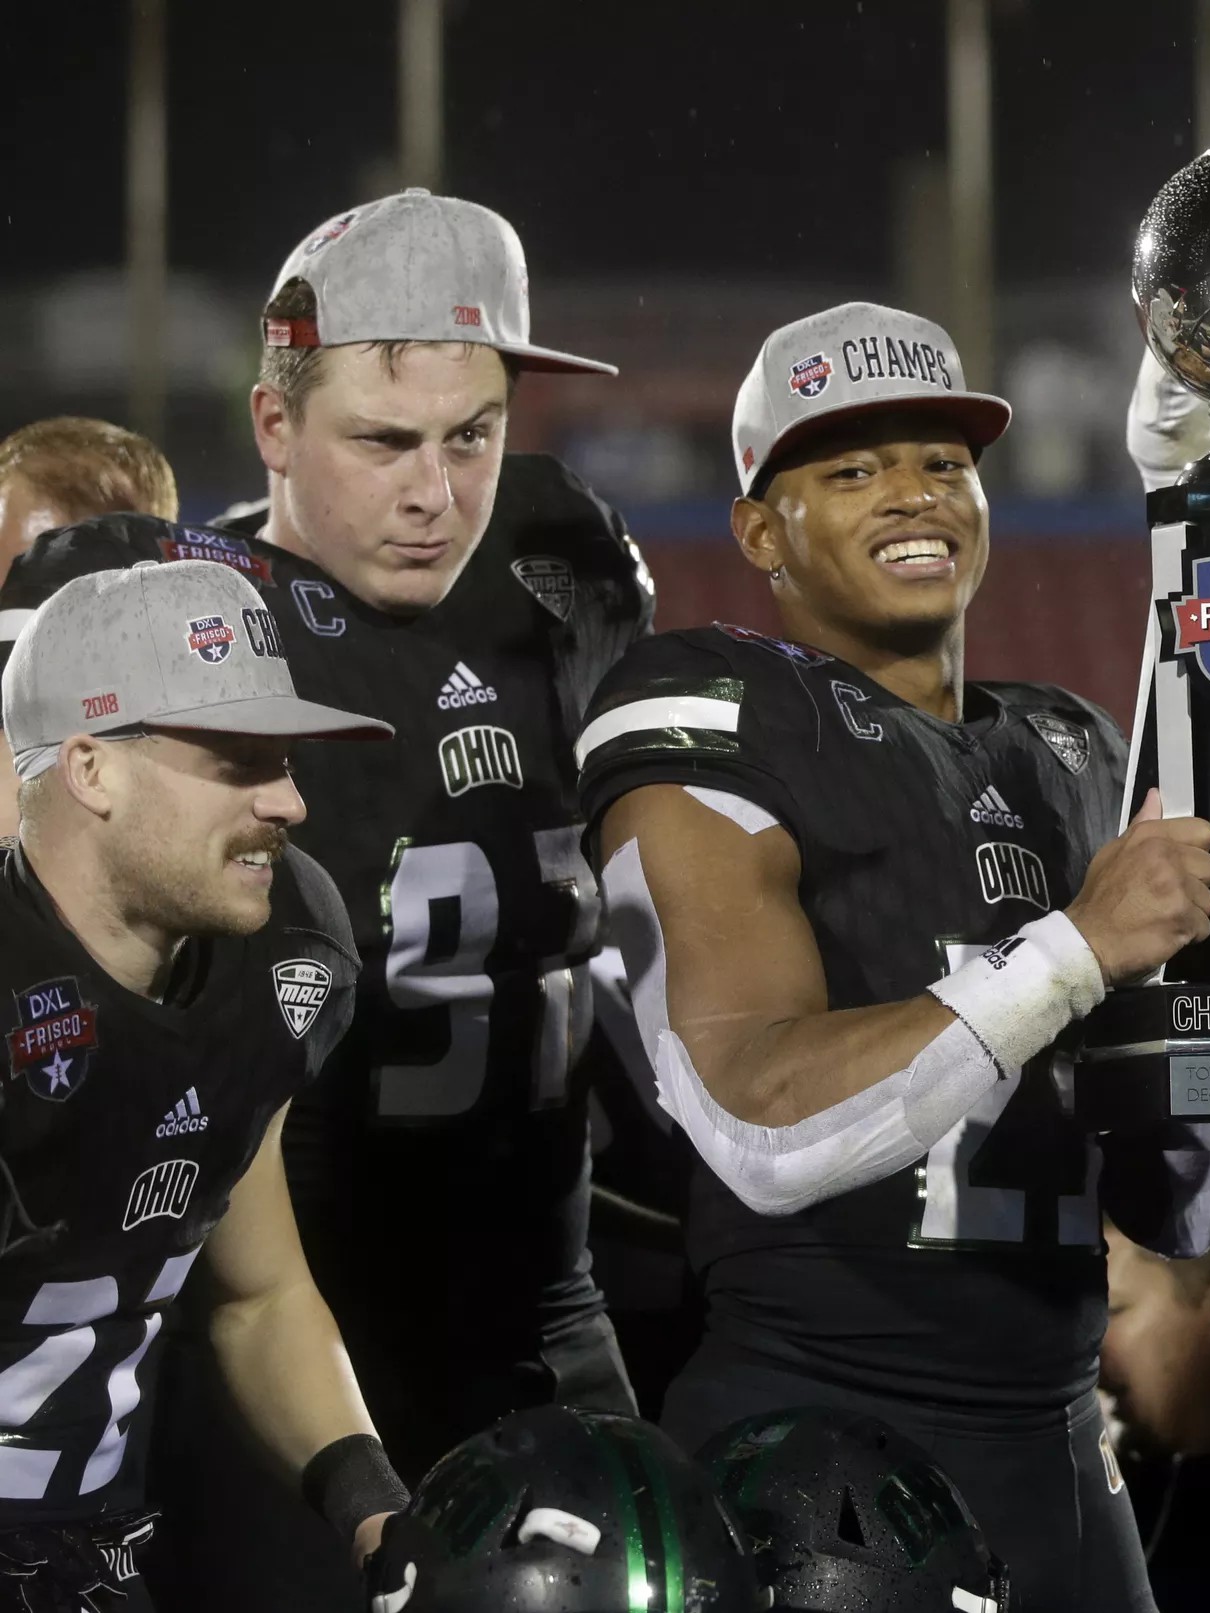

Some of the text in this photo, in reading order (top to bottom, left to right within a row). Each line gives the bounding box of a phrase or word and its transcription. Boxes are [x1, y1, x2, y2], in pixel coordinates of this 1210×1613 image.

[796, 359, 818, 372] DXL
[842, 336, 952, 391] CHAMPS
[184, 528, 236, 552] DXL
[177, 544, 252, 569] FRISCO
[290, 579, 347, 637] C
[195, 628, 227, 645] FRISCO
[196, 618, 219, 631] DXL
[82, 693, 120, 719] 2018
[437, 686, 498, 710] adidas
[830, 679, 883, 742] C
[438, 725, 524, 797] OHIO
[970, 808, 1025, 830] adidas
[975, 842, 1050, 911] OHIO
[29, 987, 70, 1019] DXL
[279, 983, 326, 1005] MAC
[25, 1014, 81, 1054] FRISCO
[156, 1115, 209, 1138] adidas
[122, 1159, 199, 1231] OHIO
